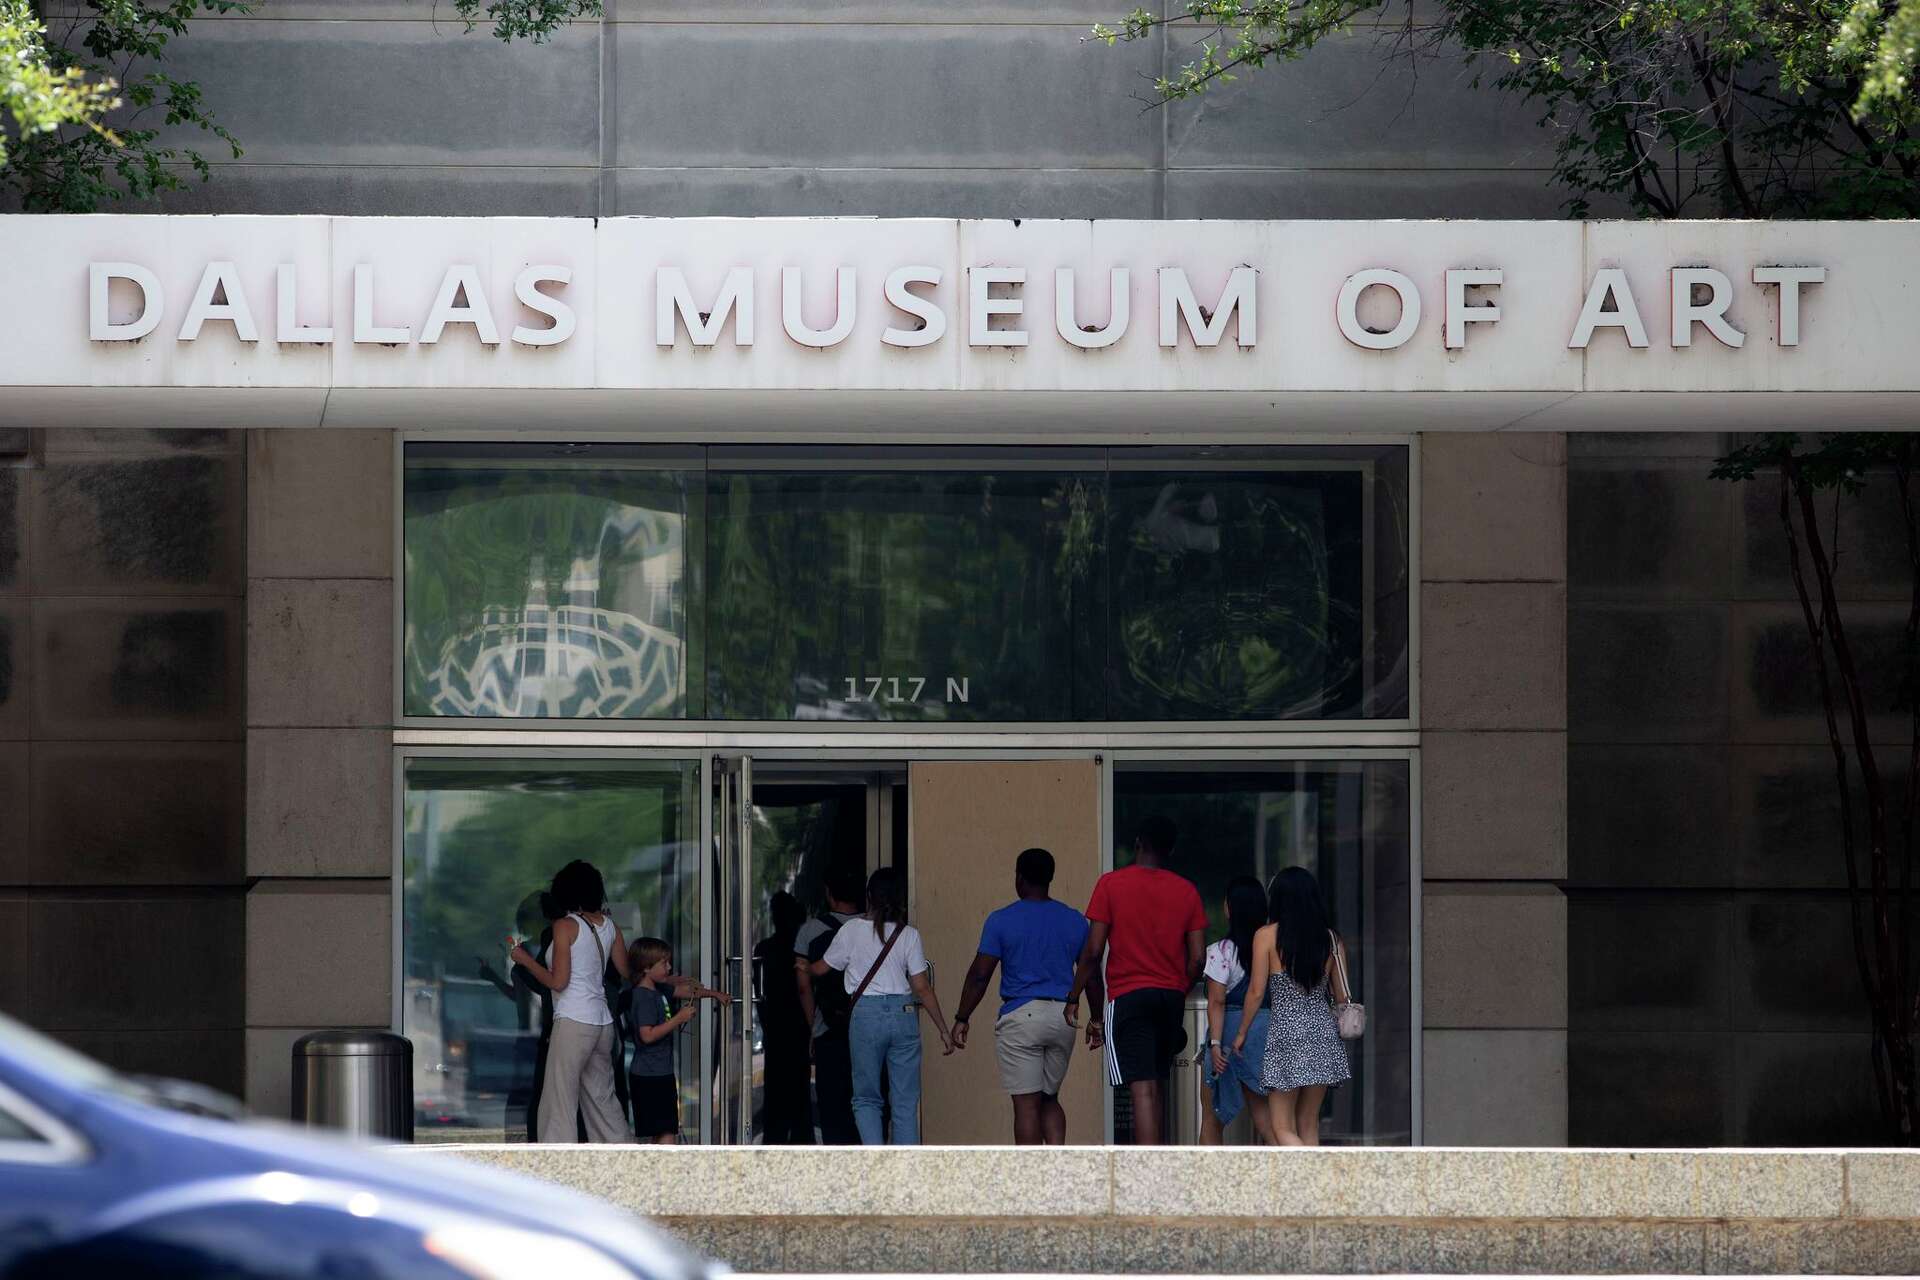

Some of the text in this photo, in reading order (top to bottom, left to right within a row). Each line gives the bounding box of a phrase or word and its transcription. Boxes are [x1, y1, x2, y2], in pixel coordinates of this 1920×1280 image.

[88, 261, 1826, 350] DALLAS MUSEUM OF ART
[844, 676, 969, 703] 1717 N
